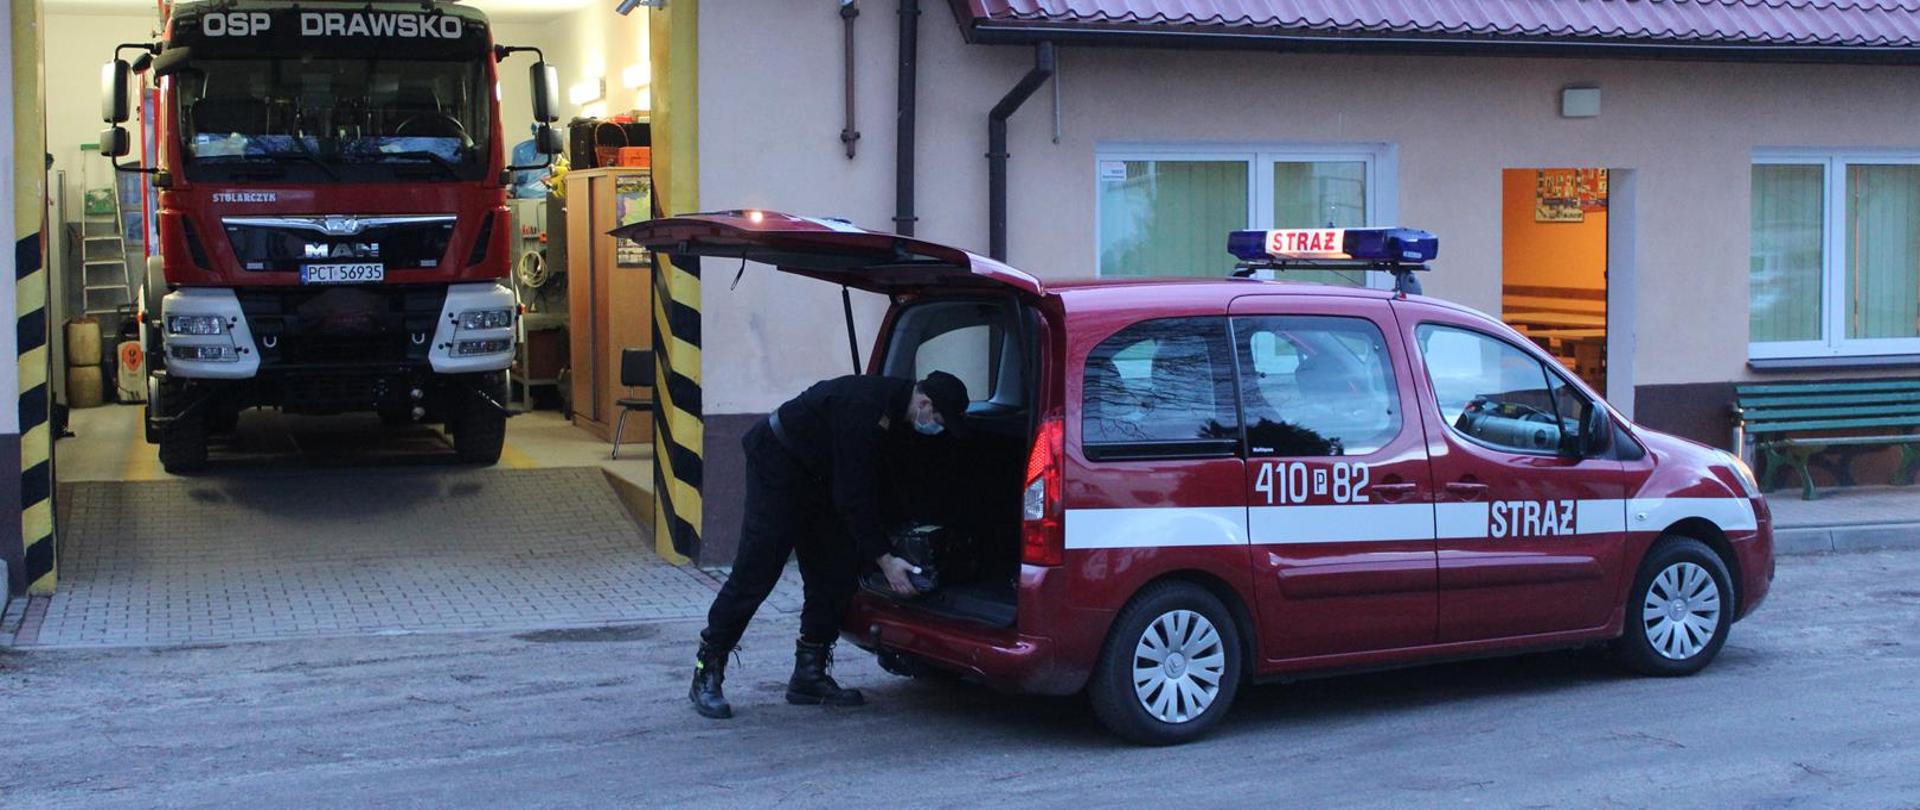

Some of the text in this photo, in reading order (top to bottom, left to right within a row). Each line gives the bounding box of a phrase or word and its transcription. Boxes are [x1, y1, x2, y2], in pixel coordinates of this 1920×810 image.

[203, 13, 462, 38] OSP DRAWSKO
[212, 193, 276, 202] STOLARCZYK
[305, 243, 379, 257] MAN
[308, 265, 382, 280] PCT 56935
[1255, 462, 1308, 504] 410
[1333, 462, 1369, 503] 82
